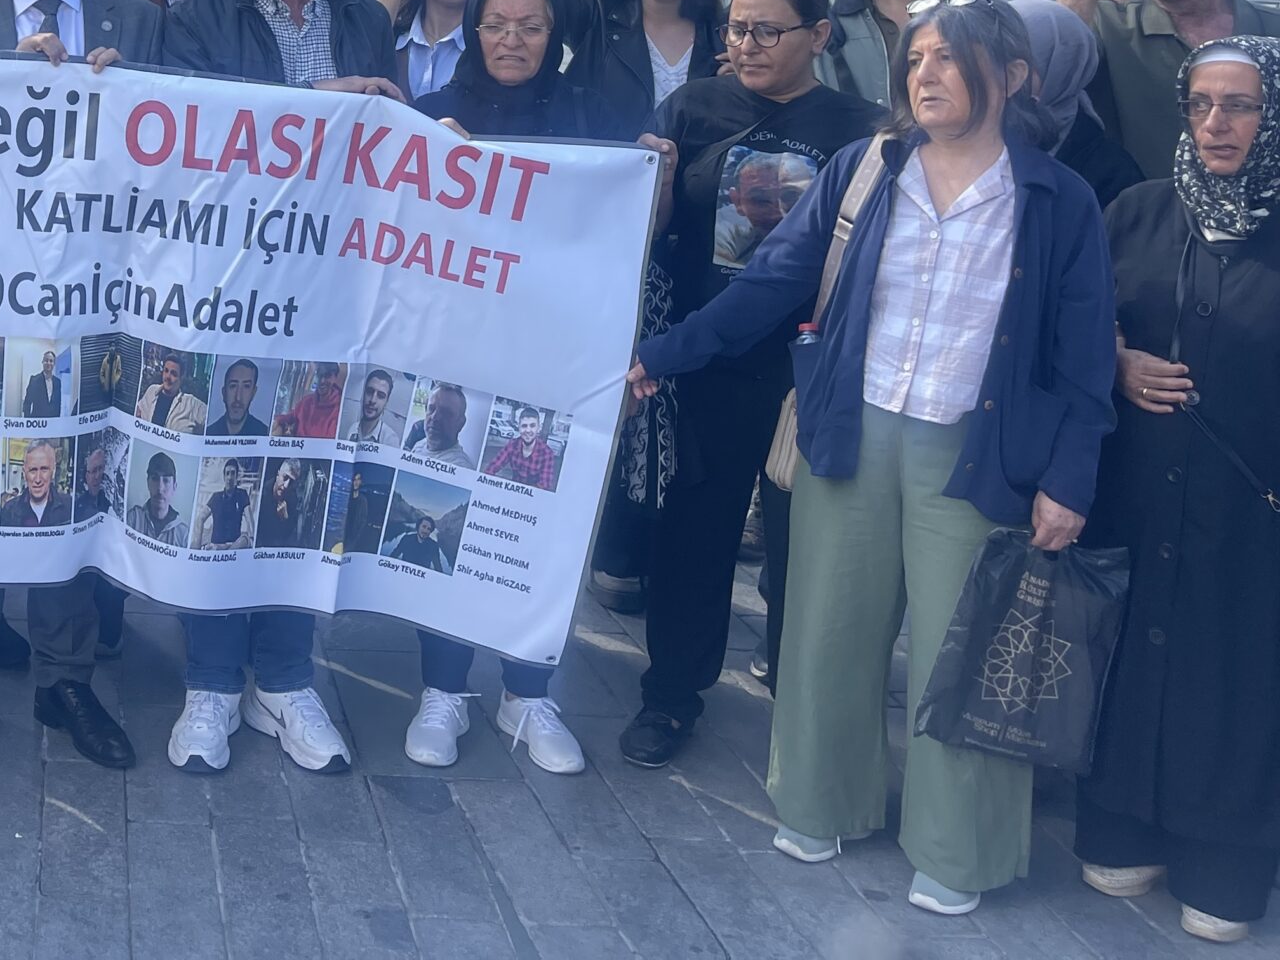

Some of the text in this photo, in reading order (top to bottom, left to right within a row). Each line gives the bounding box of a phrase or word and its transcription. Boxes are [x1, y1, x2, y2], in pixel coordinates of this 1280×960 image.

[125, 100, 325, 181] OLASI
[343, 122, 550, 222] KASIT
[17, 187, 227, 247] KATLİAMI
[244, 198, 329, 265] İÇİN
[339, 218, 521, 294] ADALET
[4, 419, 47, 429] Şivan DOLU
[79, 415, 89, 425] Efe
[135, 421, 180, 443] Onur ALADAĞ
[270, 438, 304, 450] Özkan BAŞ
[401, 453, 423, 465] Adem
[477, 476, 533, 497] Ahmet KARTAL
[472, 500, 537, 526] Ahmed MEDHUŞ
[467, 521, 520, 543] Ahmet SEVER
[212, 553, 237, 562] ALADAĞ
[276, 552, 305, 560] AKBULUT
[462, 543, 529, 570] Gökhan YILDIRIM
[401, 565, 426, 579] TEVLEK
[457, 564, 472, 575] Shir
[474, 568, 494, 583] Agha
